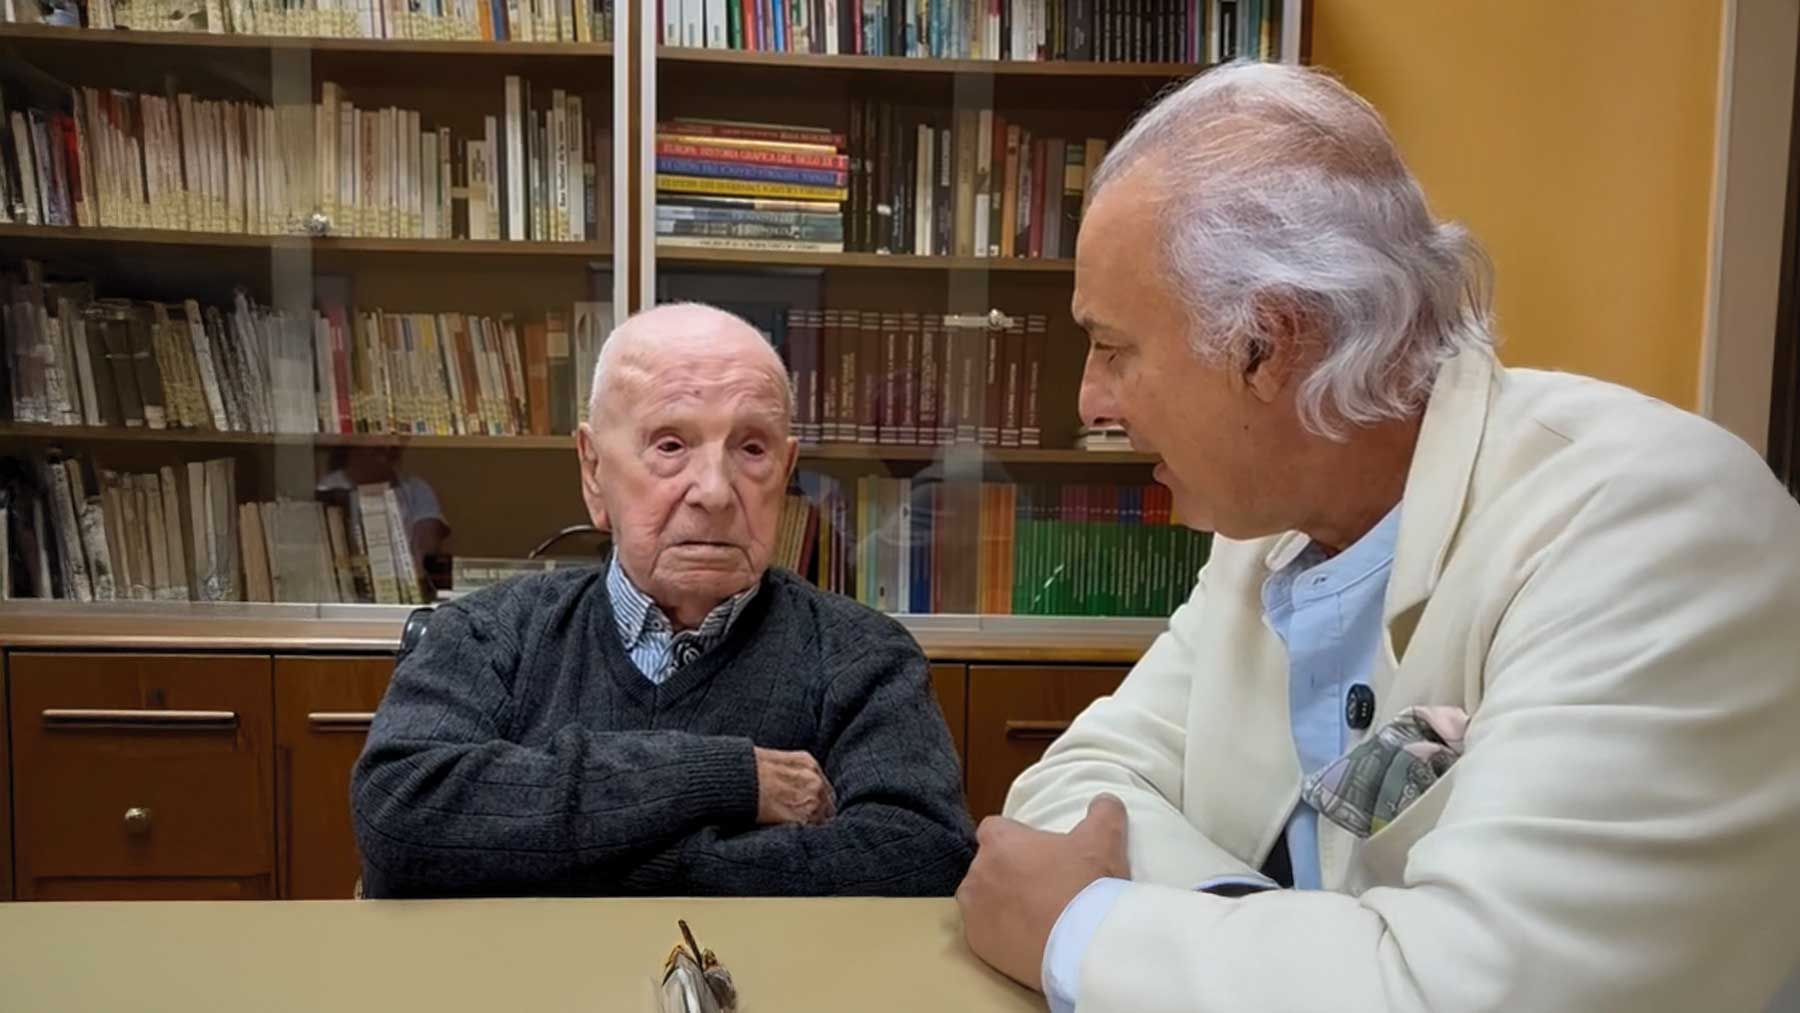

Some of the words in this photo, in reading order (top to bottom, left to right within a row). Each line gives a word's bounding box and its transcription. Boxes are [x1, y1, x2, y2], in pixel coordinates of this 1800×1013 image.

[663, 143, 697, 156] EUROPA
[699, 146, 738, 160] HISTORIA
[777, 152, 793, 164] DEL
[795, 154, 821, 167] SIGLO
